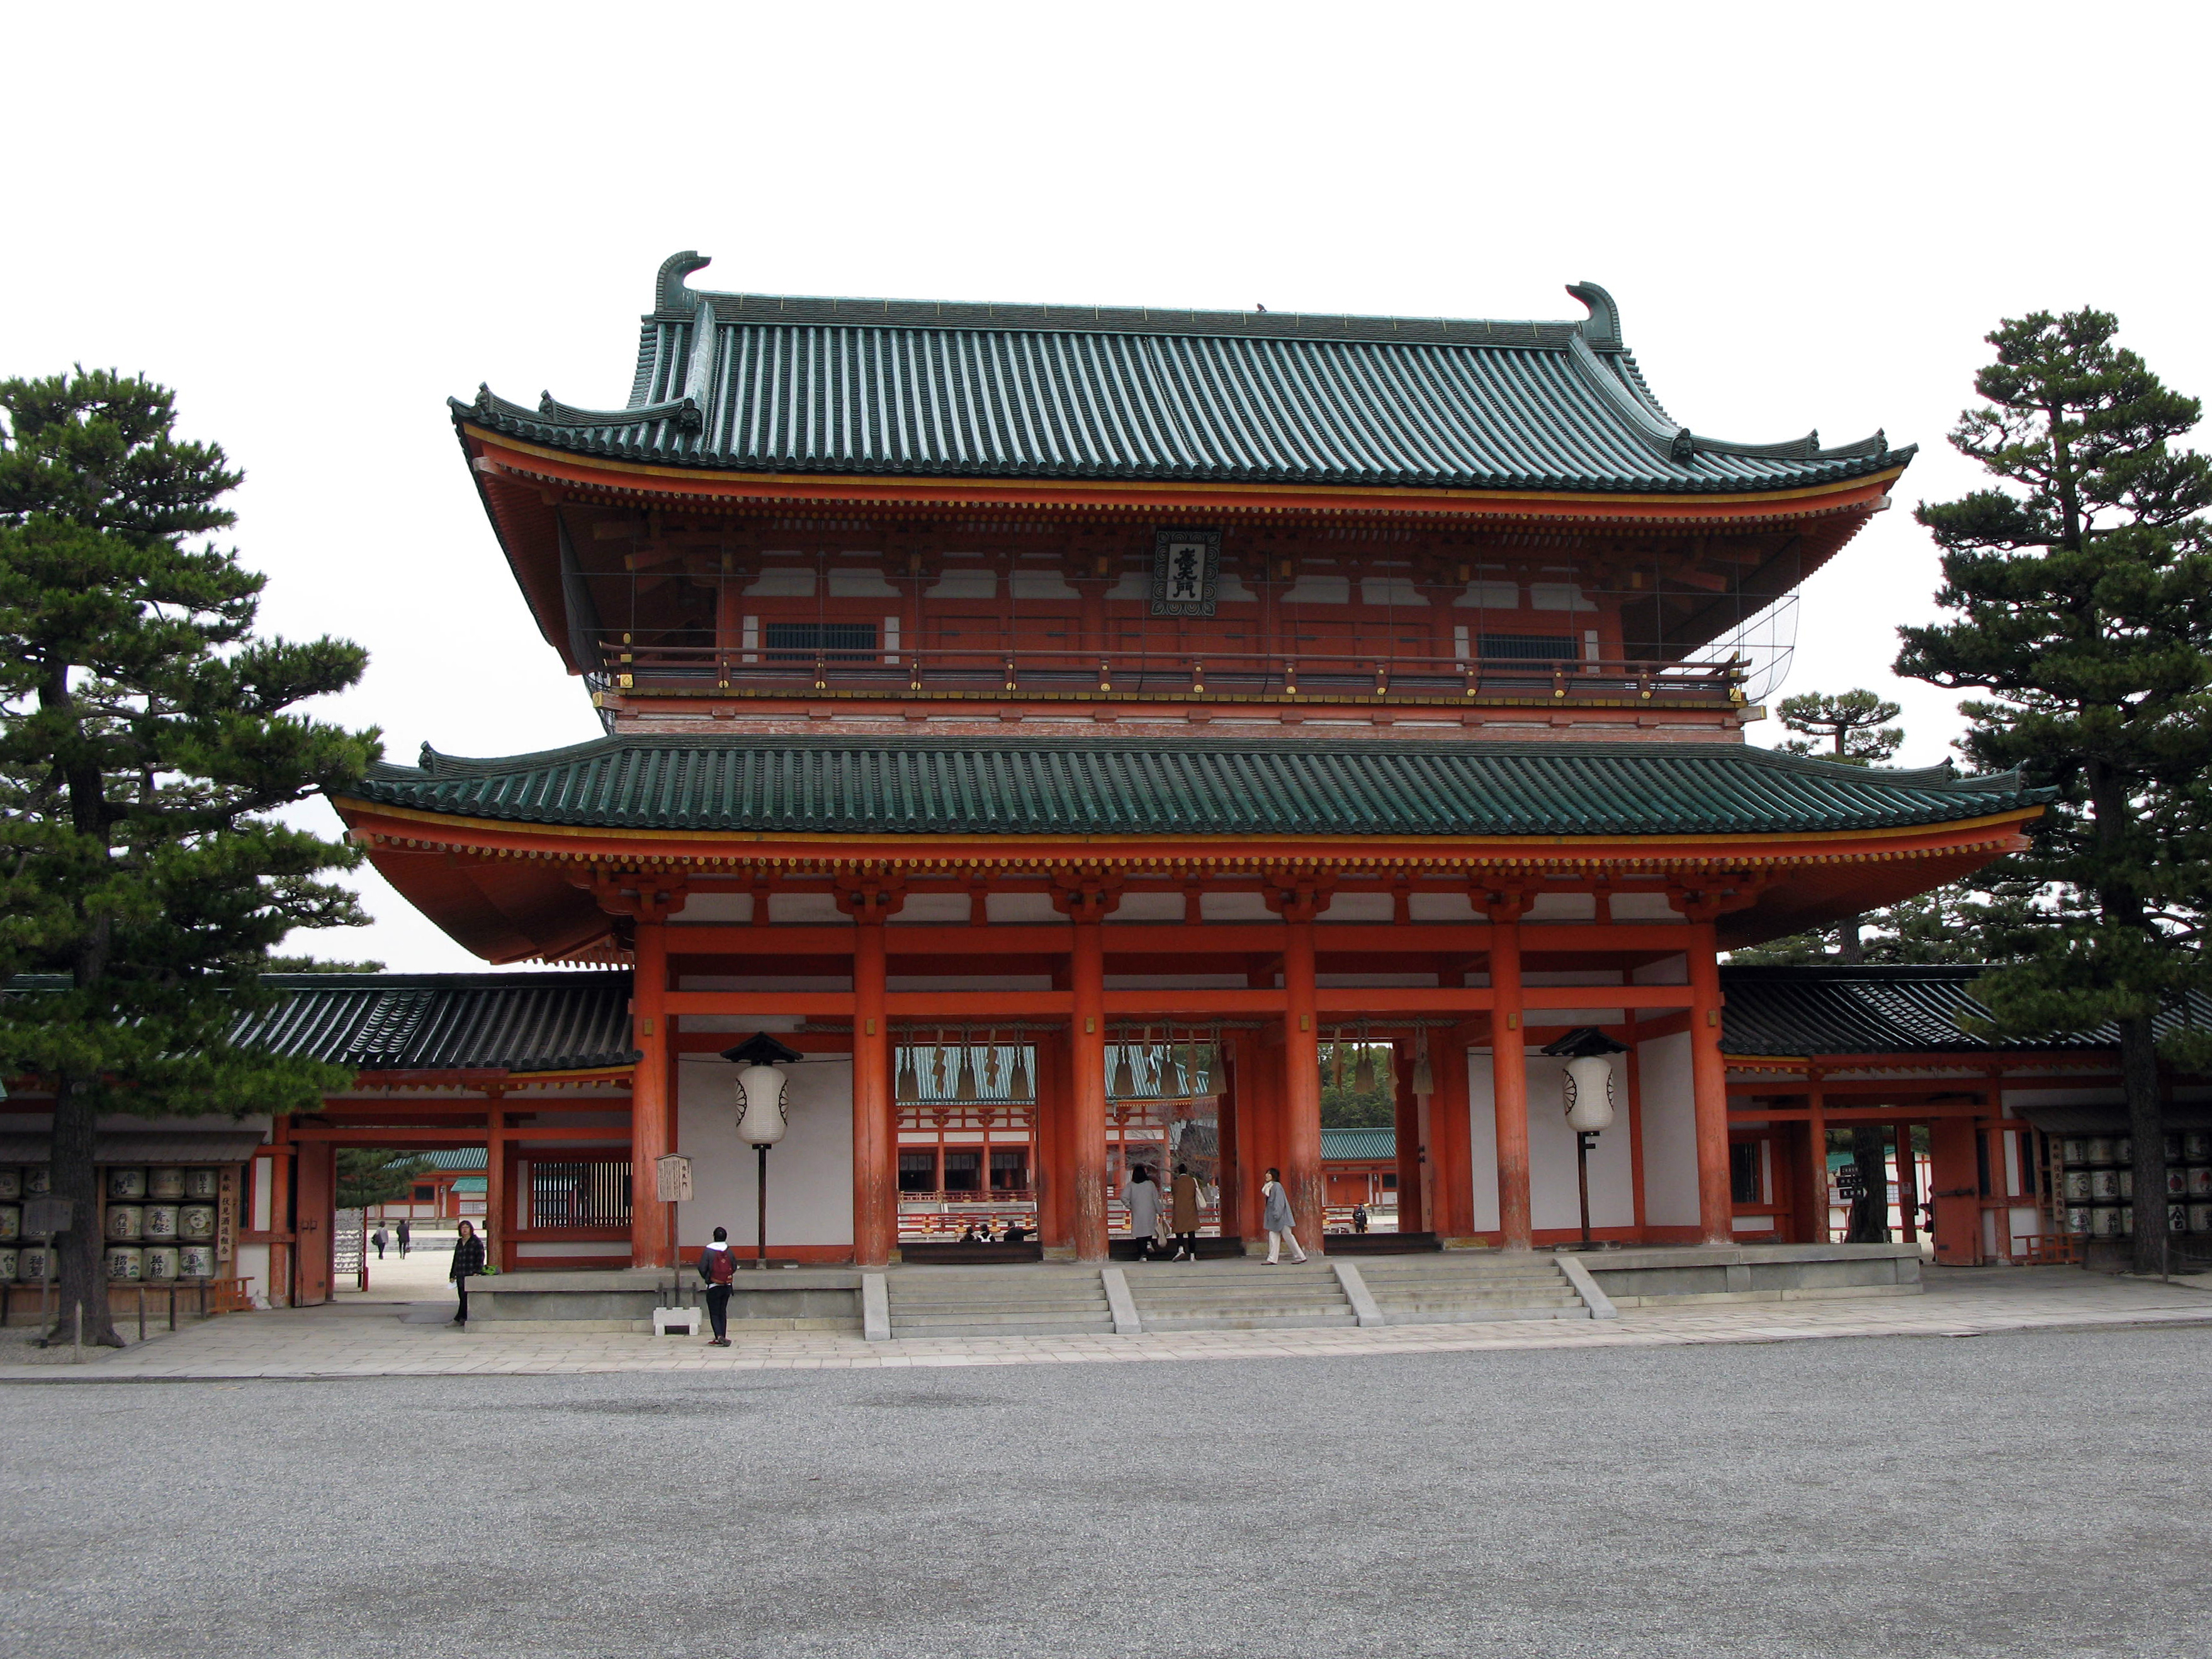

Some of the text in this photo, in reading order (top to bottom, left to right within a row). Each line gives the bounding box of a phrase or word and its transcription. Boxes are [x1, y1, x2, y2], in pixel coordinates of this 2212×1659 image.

[151, 1211, 166, 1233] 黄桜
[221, 1198, 230, 1254] 伏見酒造組合
